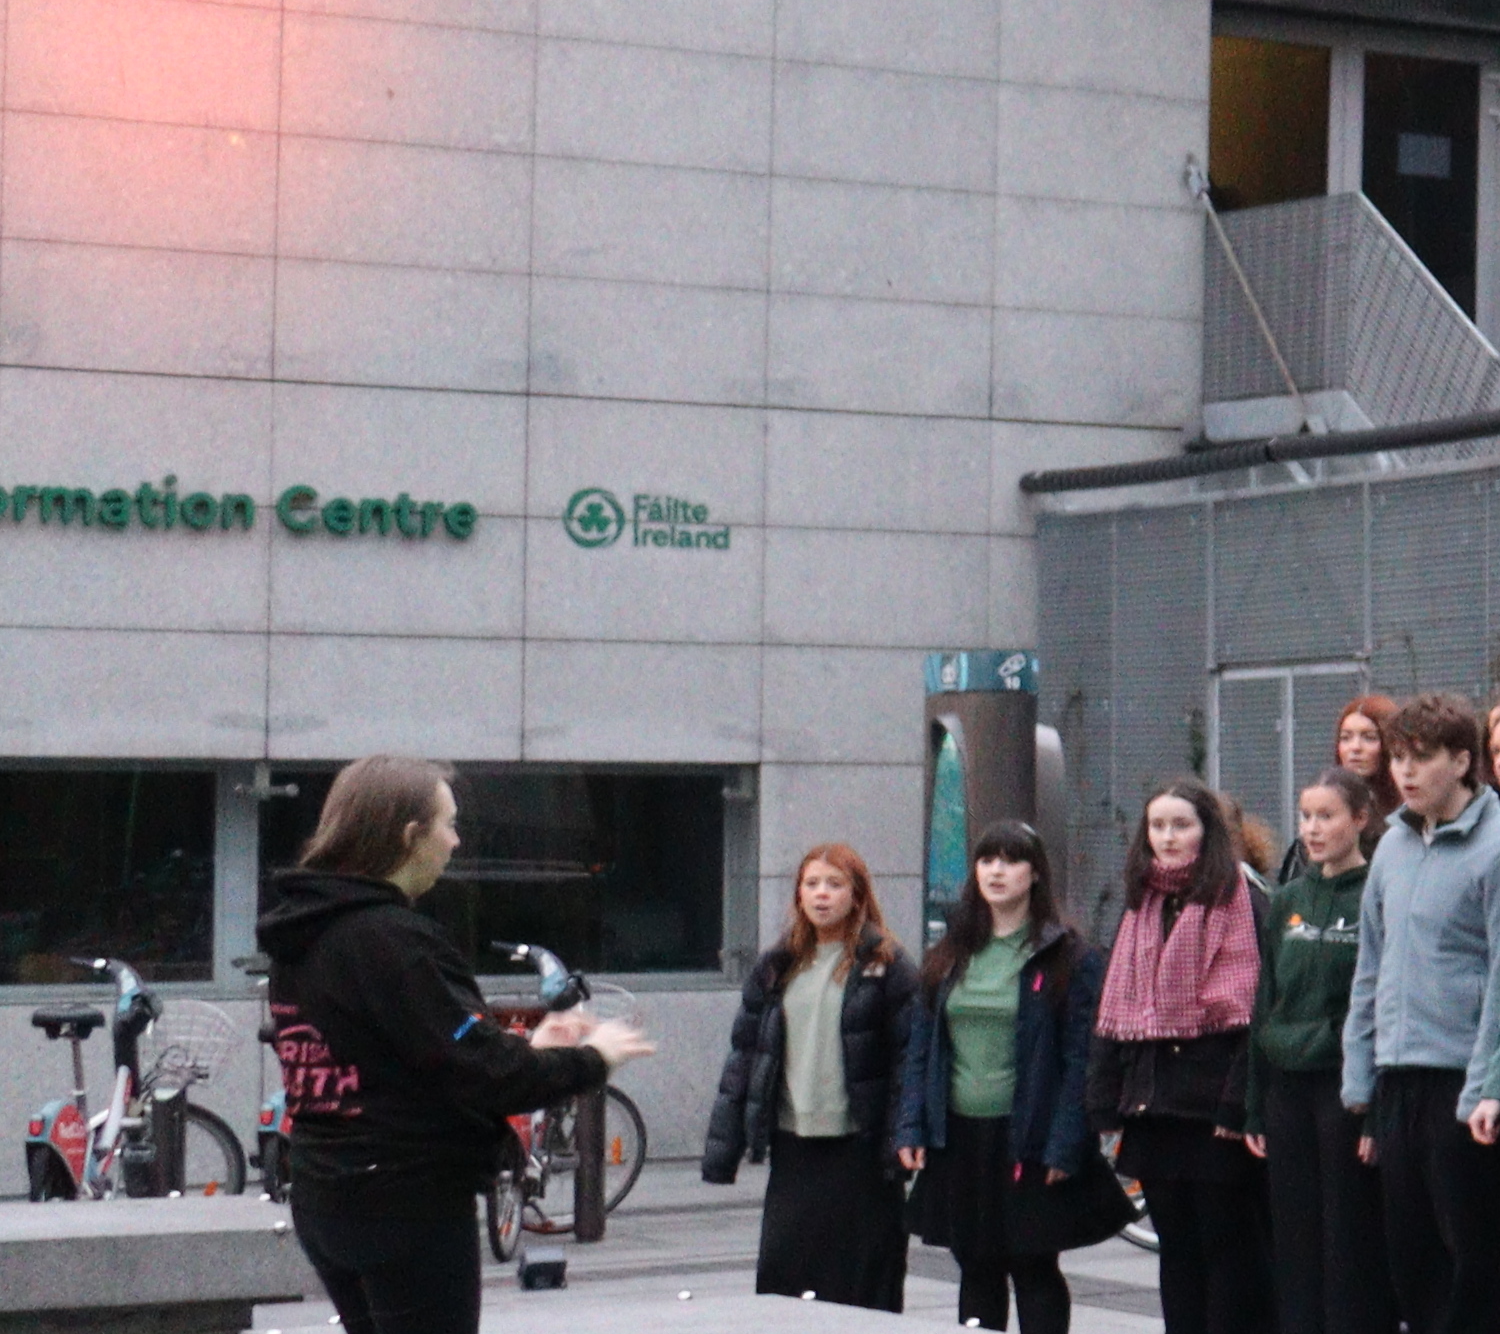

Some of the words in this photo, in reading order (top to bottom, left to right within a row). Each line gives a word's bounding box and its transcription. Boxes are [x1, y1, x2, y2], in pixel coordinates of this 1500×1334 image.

[0, 474, 255, 530] rmation
[275, 484, 478, 540] Centre
[633, 494, 708, 524] Fáilte
[633, 524, 731, 549] Ireland
